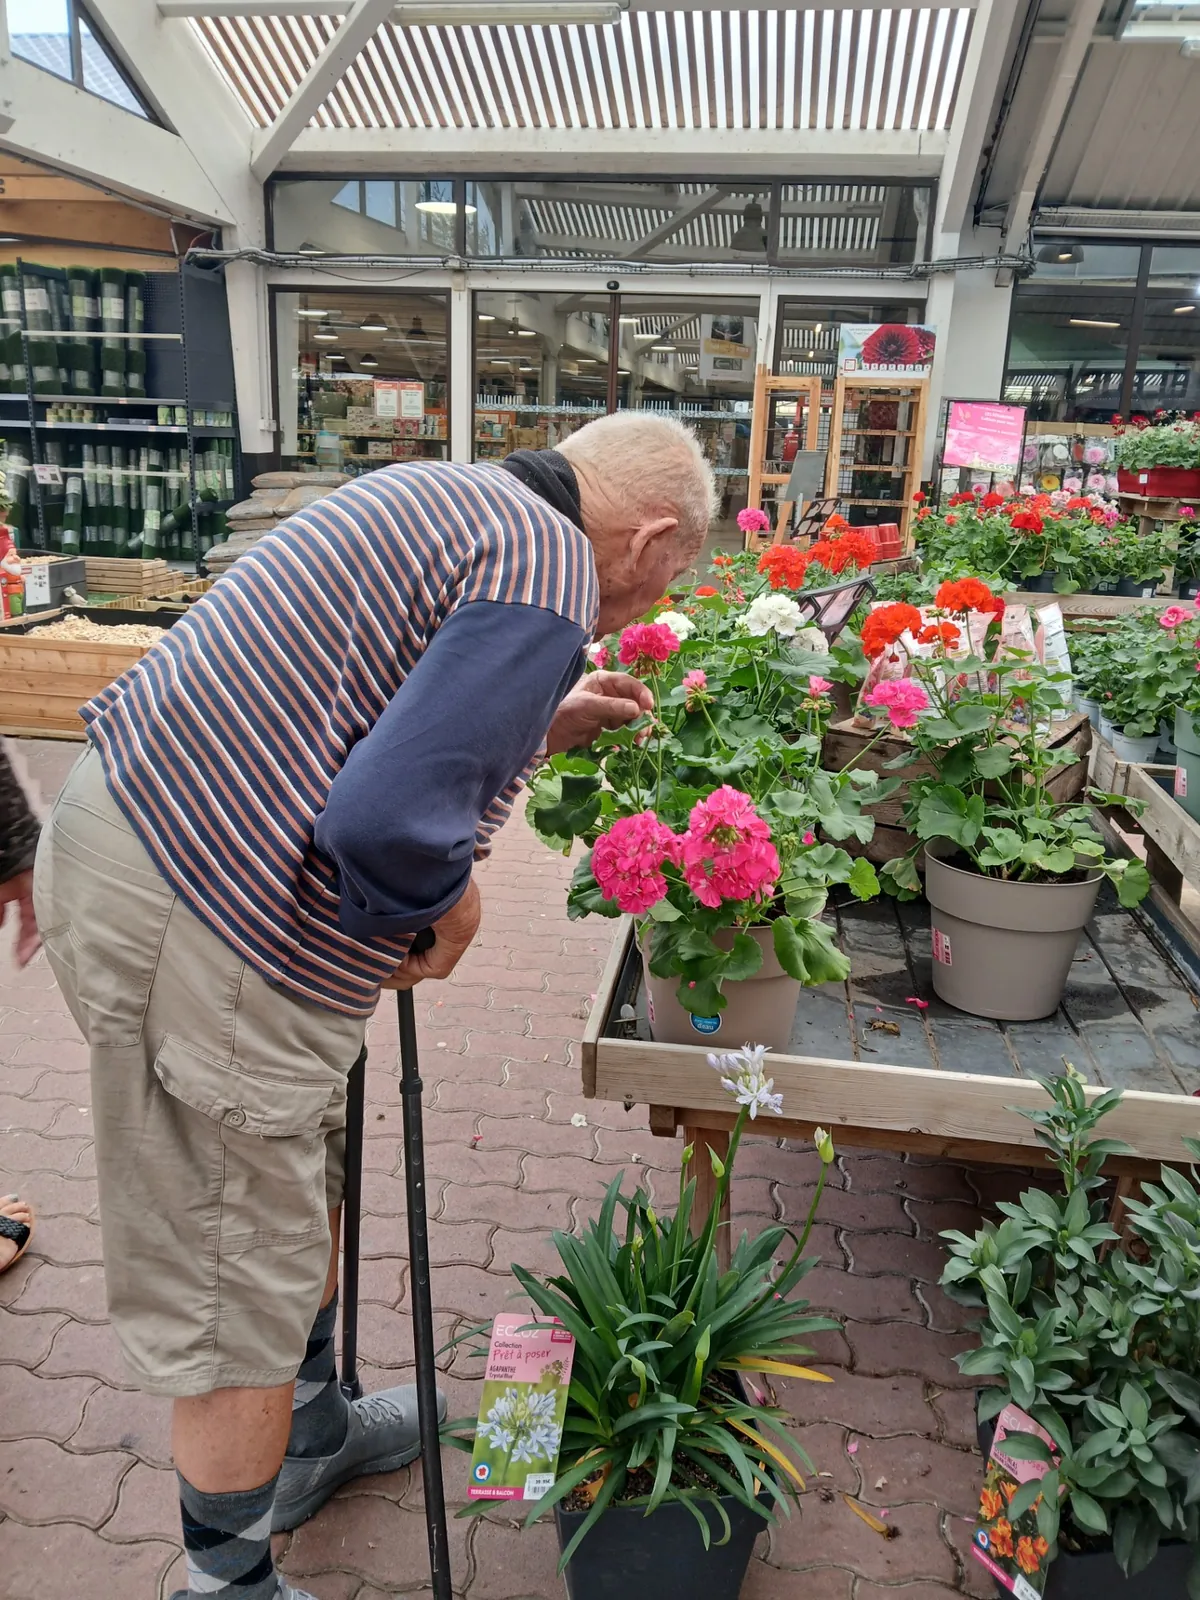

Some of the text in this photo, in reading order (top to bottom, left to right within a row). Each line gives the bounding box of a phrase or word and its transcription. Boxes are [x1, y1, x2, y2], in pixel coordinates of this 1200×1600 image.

[494, 1341, 523, 1349] Collection
[493, 1348, 552, 1364] Prêt à poser
[489, 1364, 517, 1374] AGAPANTHE
[470, 1488, 492, 1496] TERRASSE
